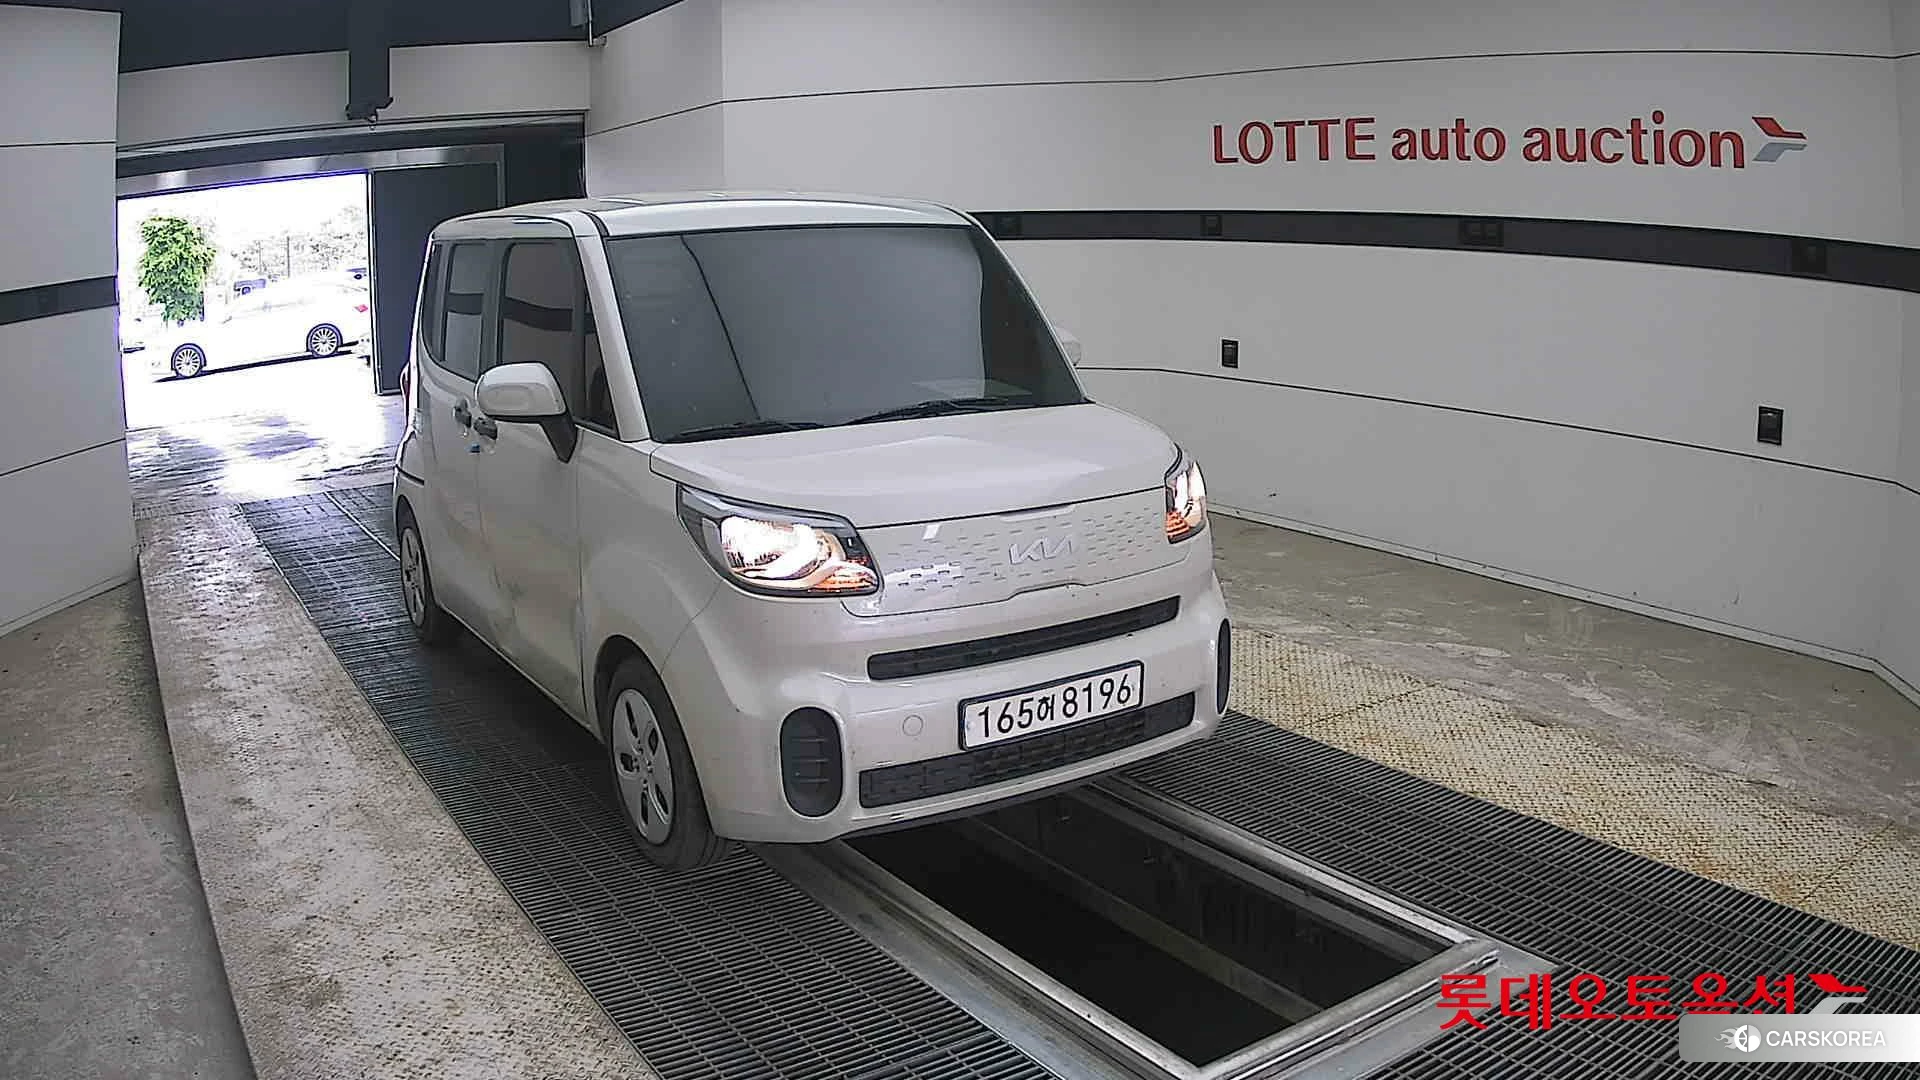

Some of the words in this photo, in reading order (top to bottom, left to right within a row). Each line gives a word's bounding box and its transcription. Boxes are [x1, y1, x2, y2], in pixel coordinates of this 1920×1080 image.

[1213, 117, 1376, 165] LOTTE
[1391, 118, 1506, 163] auto
[1522, 110, 1745, 169] auction
